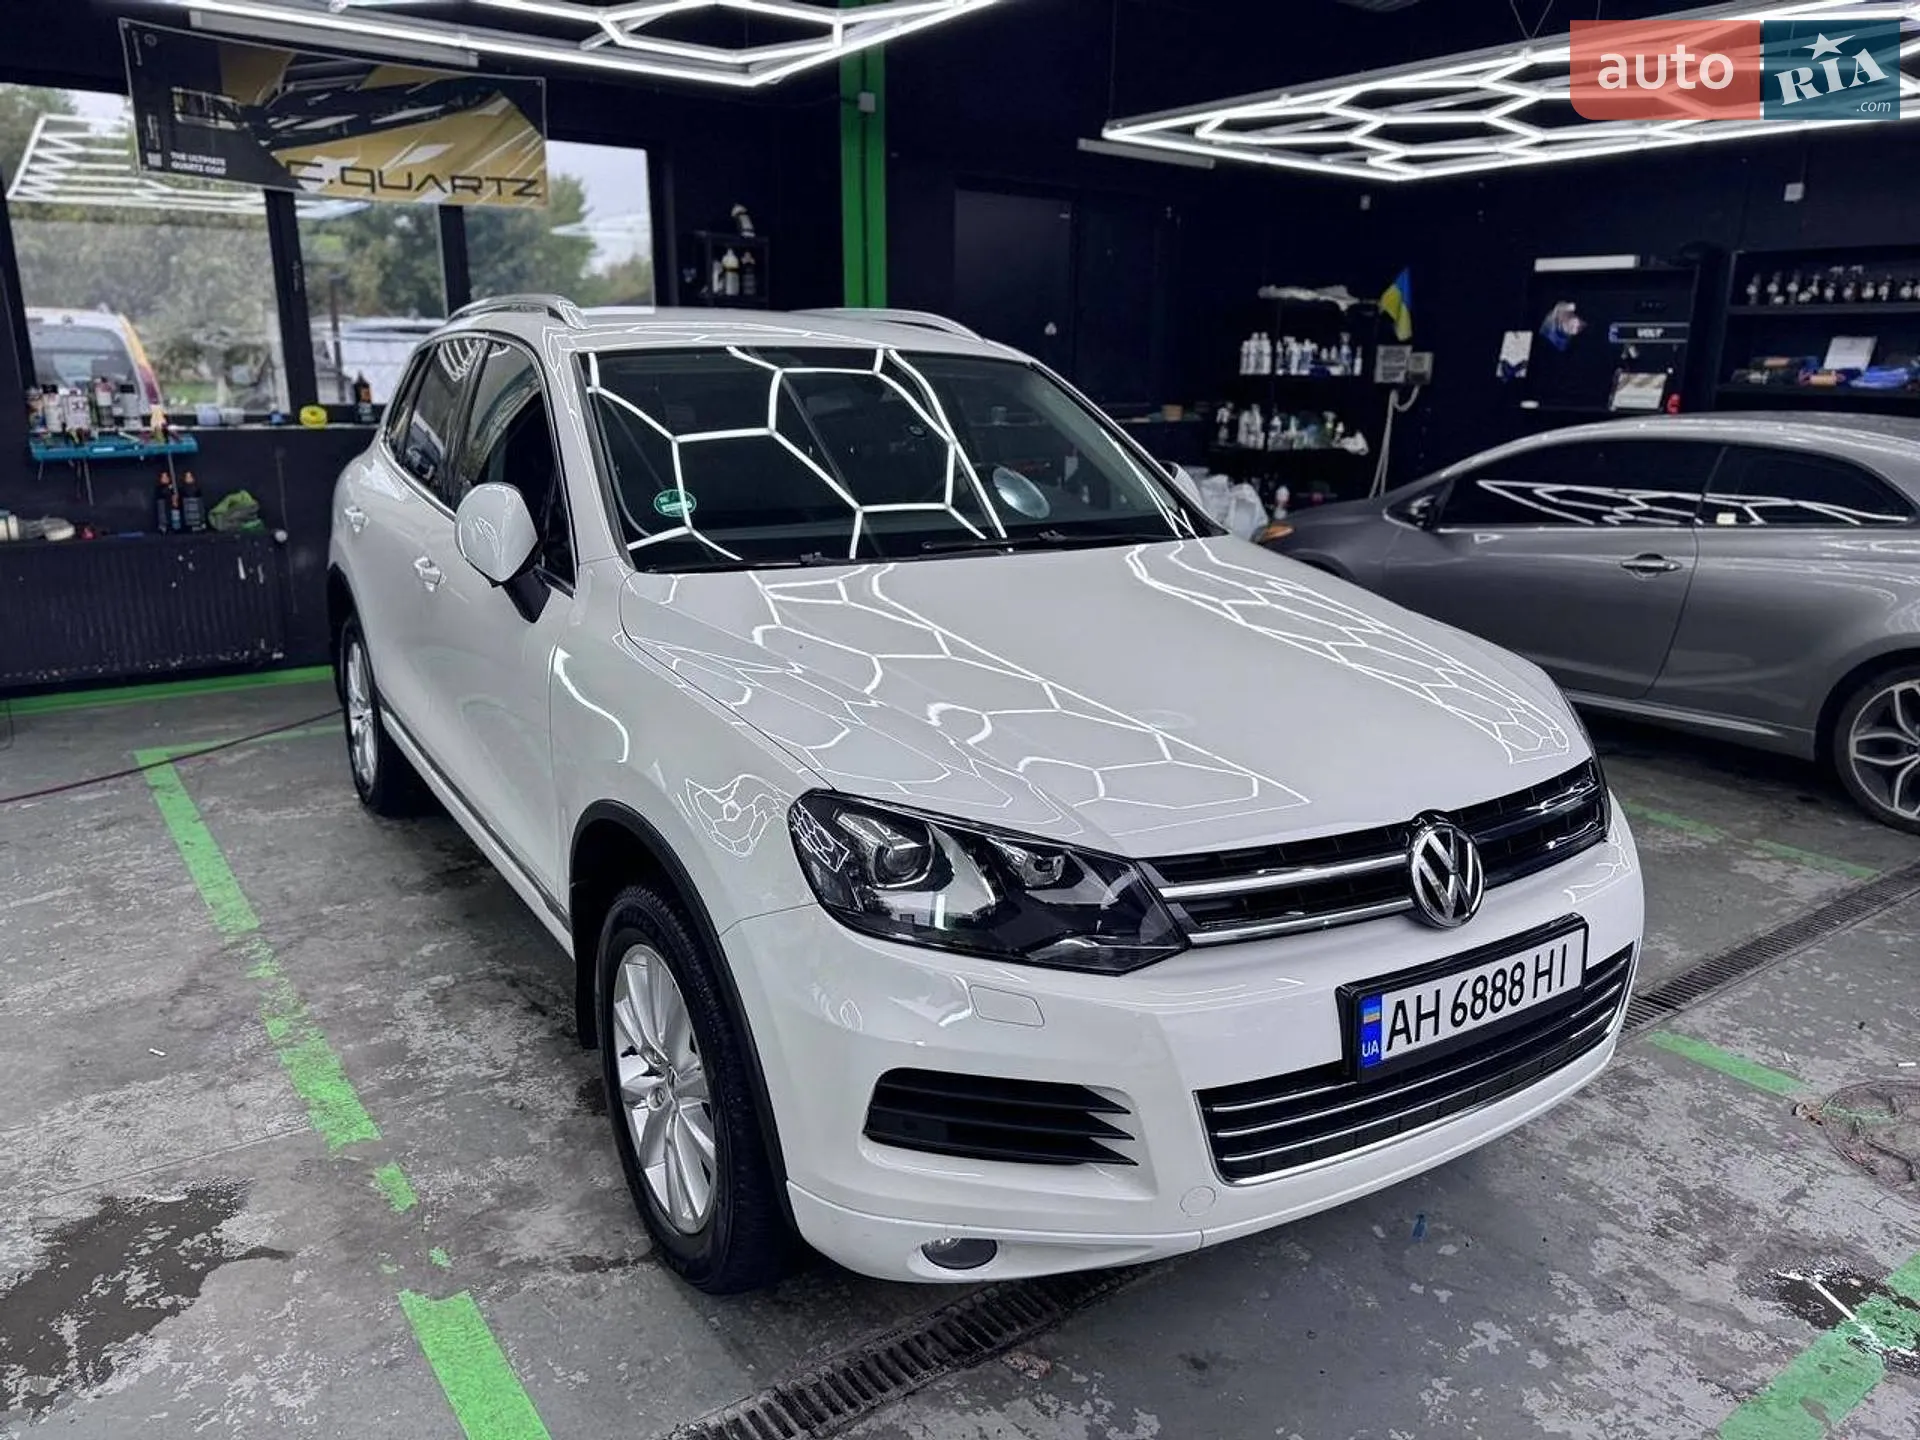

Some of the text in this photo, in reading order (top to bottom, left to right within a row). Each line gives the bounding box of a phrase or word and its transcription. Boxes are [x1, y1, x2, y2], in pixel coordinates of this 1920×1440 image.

[1386, 943, 1568, 1052] AH 6888 HI
[1361, 1039, 1380, 1058] UA
